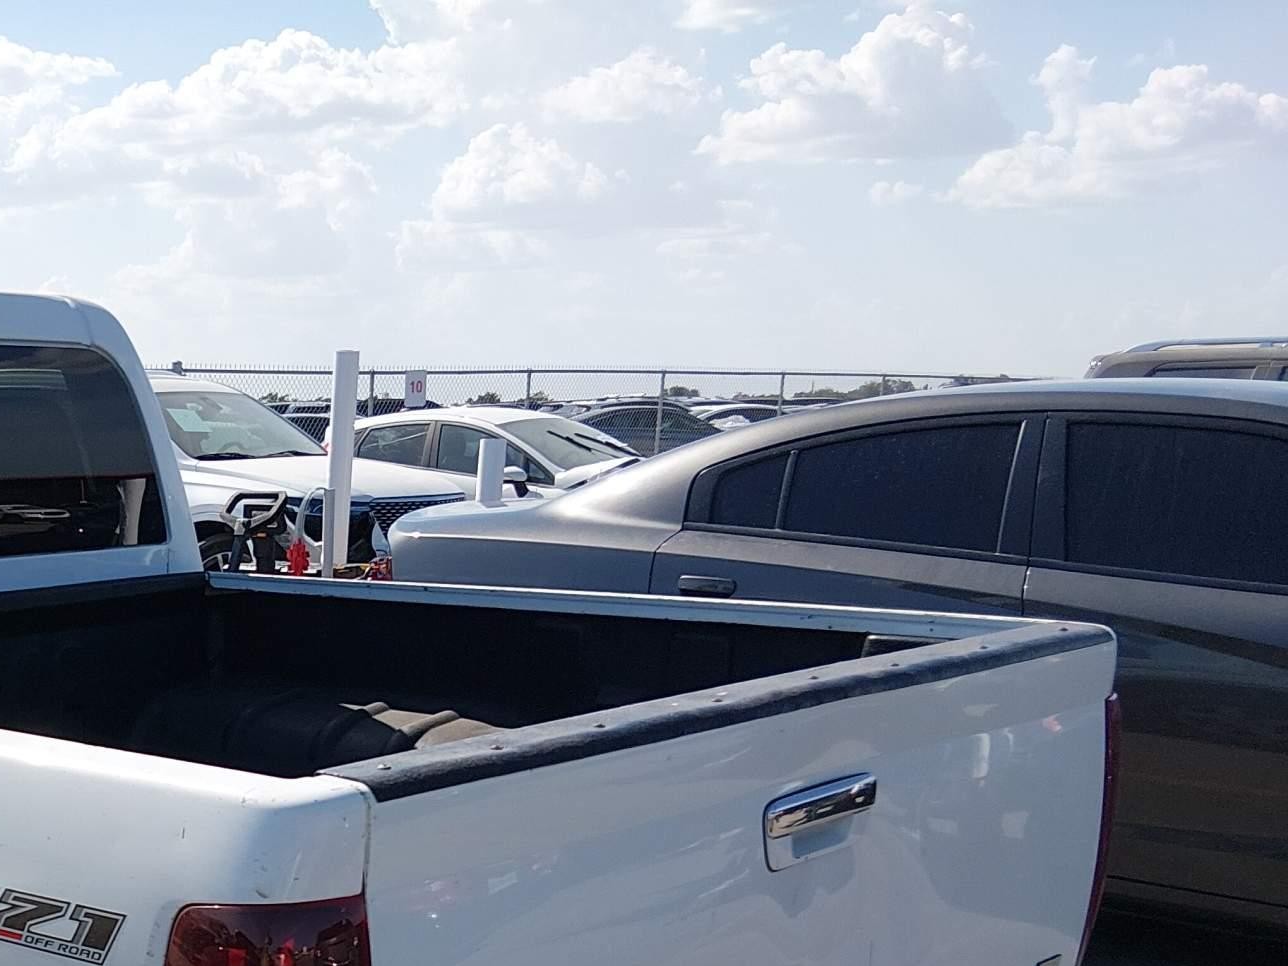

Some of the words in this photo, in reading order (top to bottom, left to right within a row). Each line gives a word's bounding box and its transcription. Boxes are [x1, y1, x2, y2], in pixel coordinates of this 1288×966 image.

[409, 380, 423, 393] 10
[24, 934, 55, 948] OFF
[57, 943, 102, 961] ROAD
